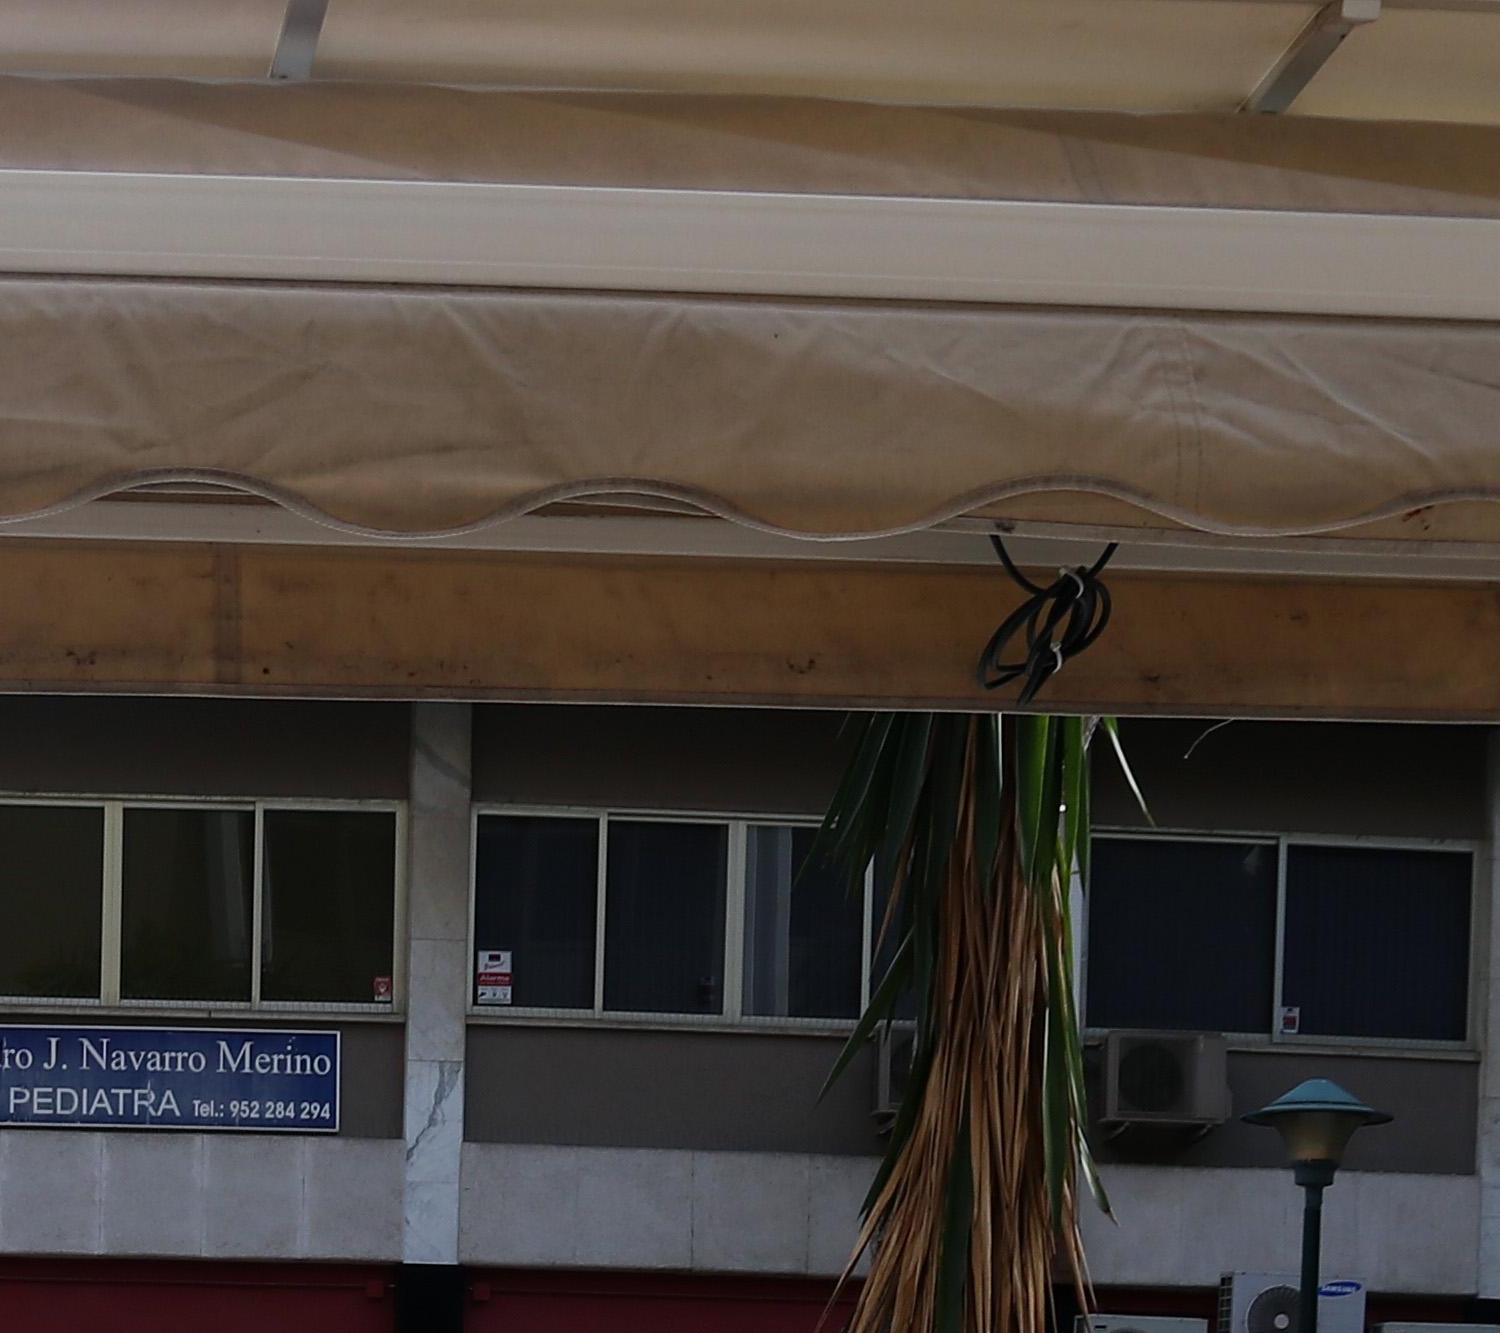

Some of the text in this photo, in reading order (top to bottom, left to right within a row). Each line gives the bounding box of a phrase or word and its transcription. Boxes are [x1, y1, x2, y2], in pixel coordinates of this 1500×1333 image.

[43, 1038, 68, 1071] J.
[79, 1038, 207, 1073] Navarro
[216, 1041, 332, 1077] Merino
[9, 1087, 331, 1121] PEDIATRA Tel.: 952 284 294
